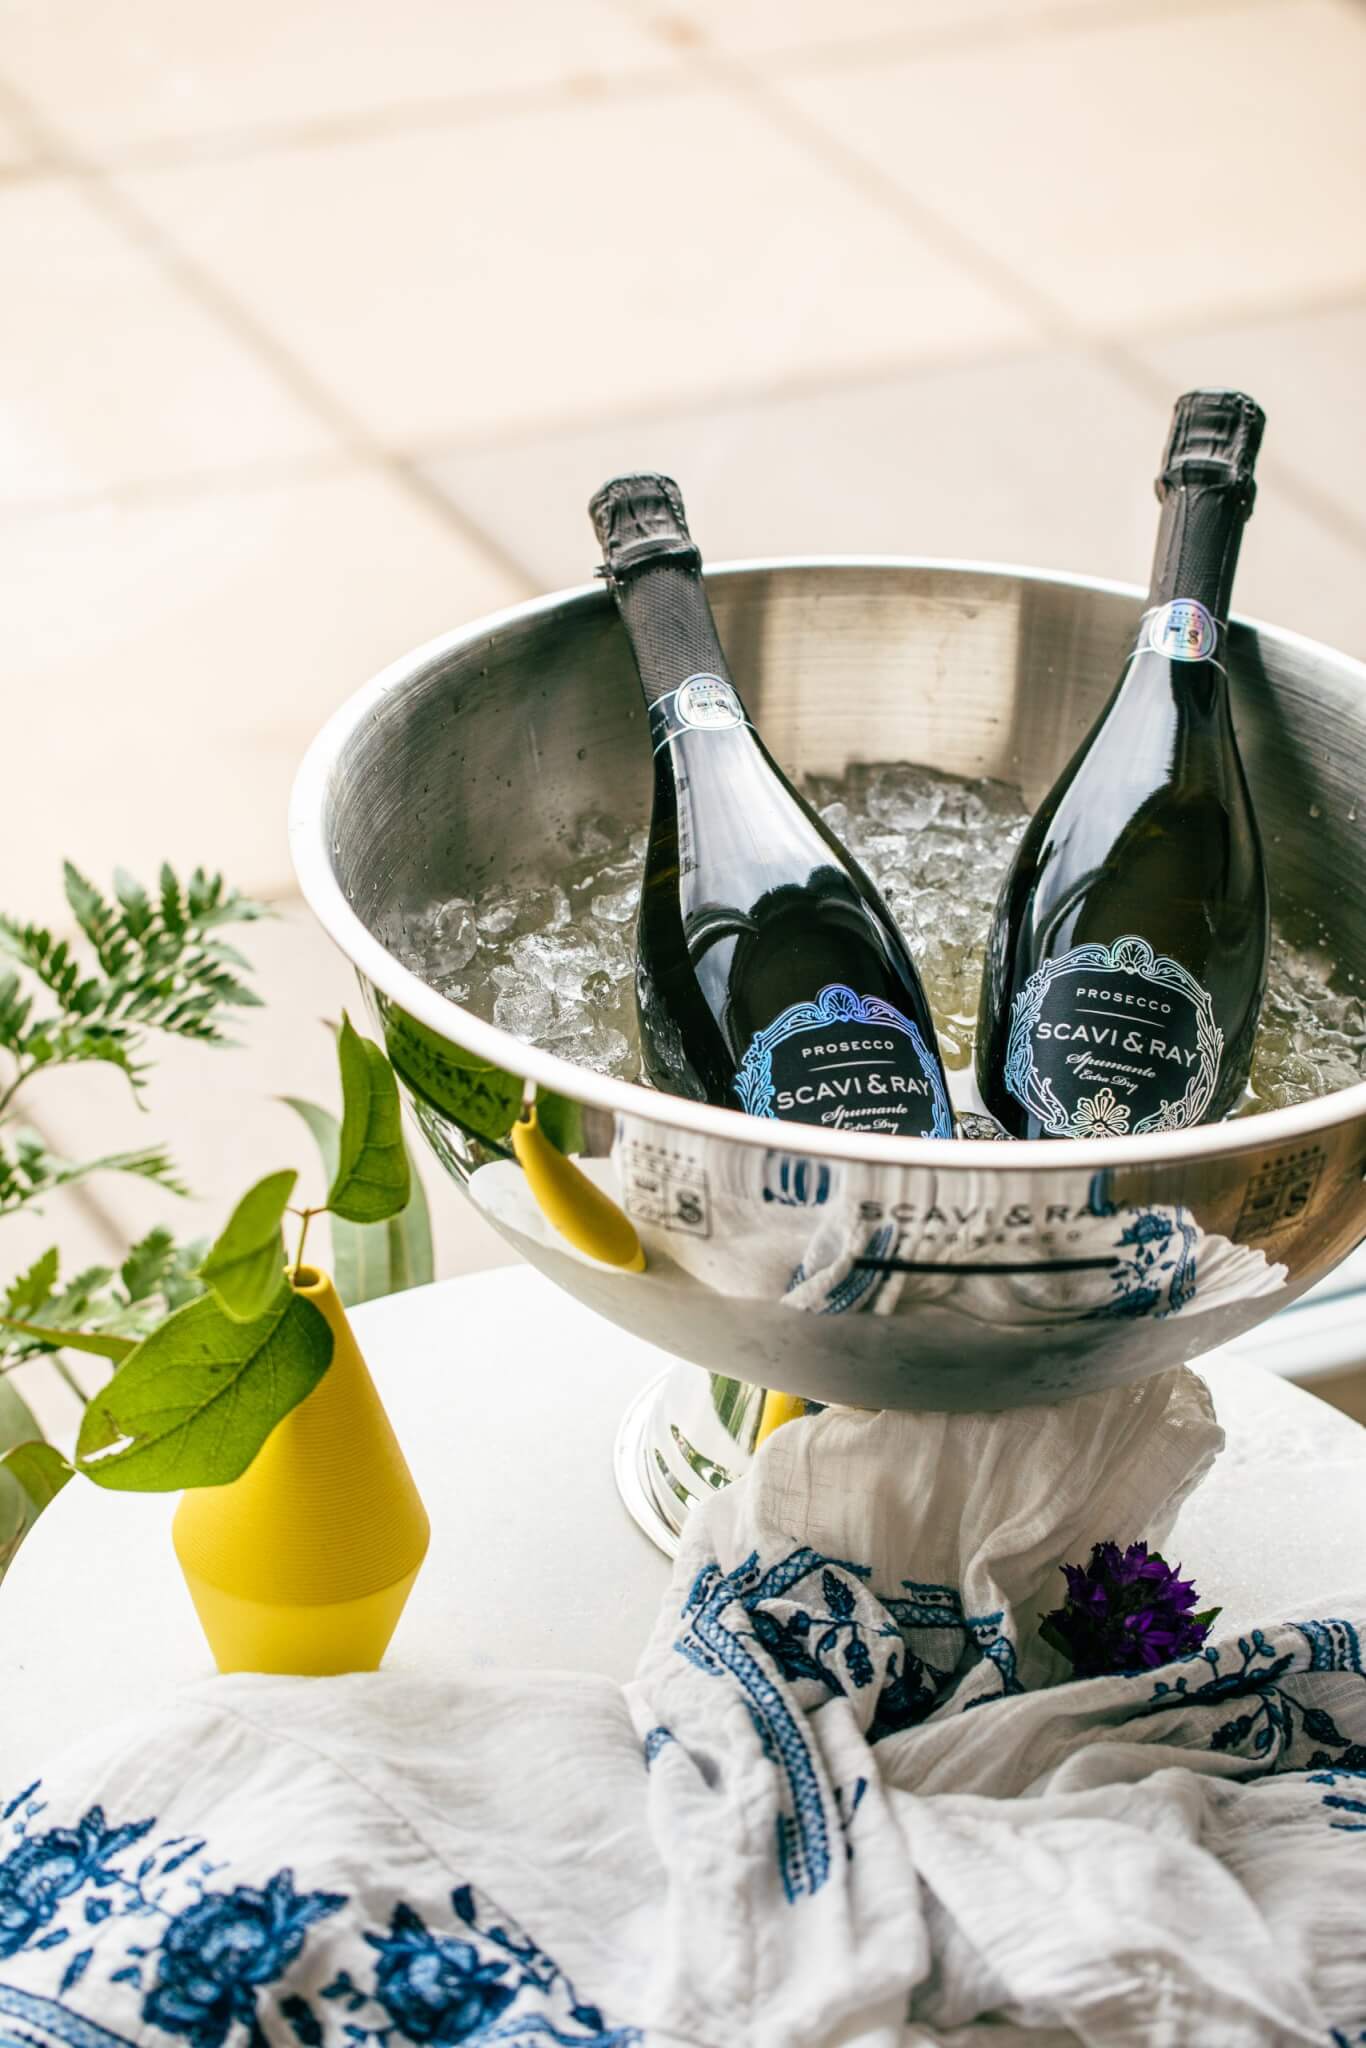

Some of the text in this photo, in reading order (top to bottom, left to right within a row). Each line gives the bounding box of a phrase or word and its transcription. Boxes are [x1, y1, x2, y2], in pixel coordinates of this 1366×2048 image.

[1076, 987, 1172, 1015] PROSECCO
[801, 1039, 895, 1059] PROSECCO
[1036, 1021, 1198, 1069] SCAVI & RAY
[1065, 1050, 1157, 1079] Spumante
[776, 1073, 931, 1111] SCAVI & RAY
[1078, 1068, 1139, 1096] Extra Dry
[820, 1103, 909, 1130] Spumante
[872, 1118, 900, 1135] Dry
